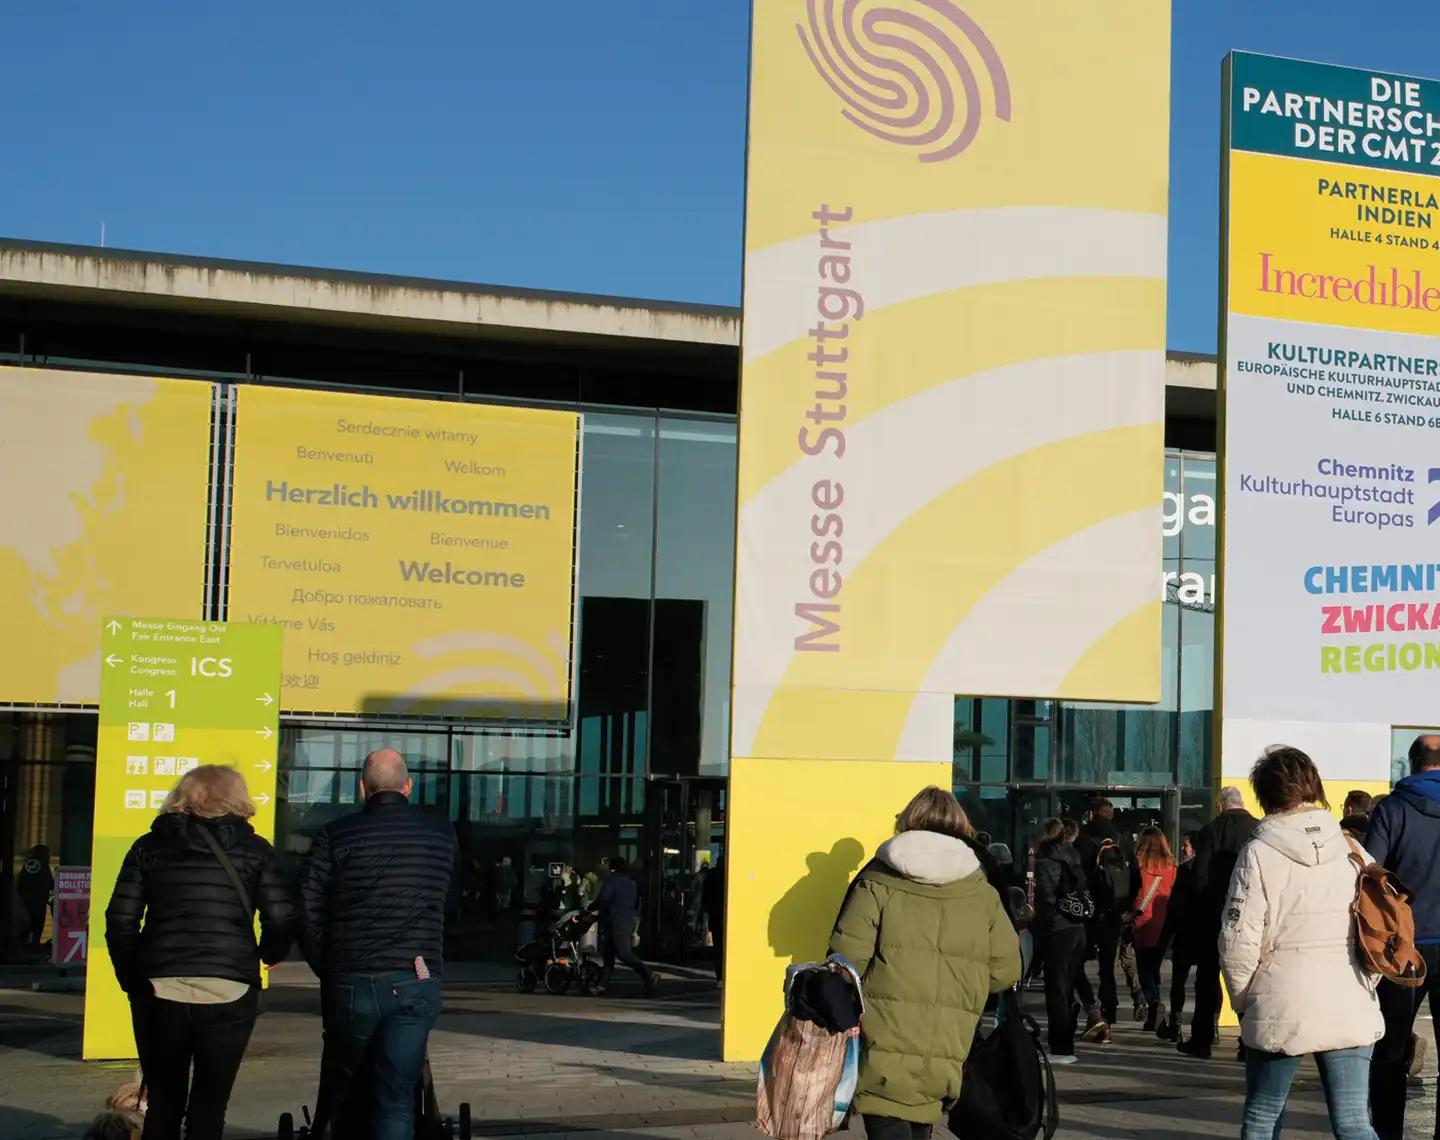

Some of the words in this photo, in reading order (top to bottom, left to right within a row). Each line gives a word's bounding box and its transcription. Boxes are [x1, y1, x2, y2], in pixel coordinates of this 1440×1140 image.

[1371, 77, 1421, 107] DIE
[1295, 122, 1356, 155] DER
[1361, 133, 1426, 163] CMT
[1357, 204, 1432, 229] INDIEN
[1330, 228, 1372, 243] HALLE
[1375, 232, 1384, 245] 4
[1386, 234, 1429, 250] STAND
[798, 203, 864, 459] Stuttgart
[1237, 360, 1325, 382] EUROPÄISCHE
[1287, 383, 1315, 396] UND
[1317, 386, 1384, 403] CHEMNITZ.
[1332, 408, 1372, 422] HALLE
[1375, 413, 1382, 424] 6
[1384, 413, 1426, 427] STAND
[337, 419, 420, 438] Serdecznie
[425, 429, 478, 446] witamy
[296, 446, 374, 465] Benvenuti
[444, 460, 506, 477] Welkom
[1317, 458, 1415, 482] Chemnitz
[1240, 474, 1415, 505] Kulturhauptstadt
[266, 480, 378, 508] Herzlich
[386, 489, 550, 520] willkommen
[1332, 505, 1414, 530] Europas
[275, 523, 370, 542] Bienvenidos
[430, 533, 508, 550] Bienvenue
[260, 555, 341, 573] Tervetuloa
[400, 560, 525, 588] Welcome
[794, 478, 844, 652] Messe
[291, 588, 343, 607] Добро
[349, 593, 442, 610] пожаловать
[132, 620, 164, 630] Messe
[167, 622, 206, 634] Eingang
[308, 617, 337, 631] Vás
[132, 631, 150, 641] Fair
[154, 633, 196, 643] Entrance
[200, 635, 221, 644] East
[132, 654, 177, 665] Kongress
[191, 657, 233, 677] ICS
[344, 648, 401, 667] geldiniz
[129, 687, 154, 697] Halle
[165, 689, 177, 709] 1
[129, 699, 148, 709] Hall
